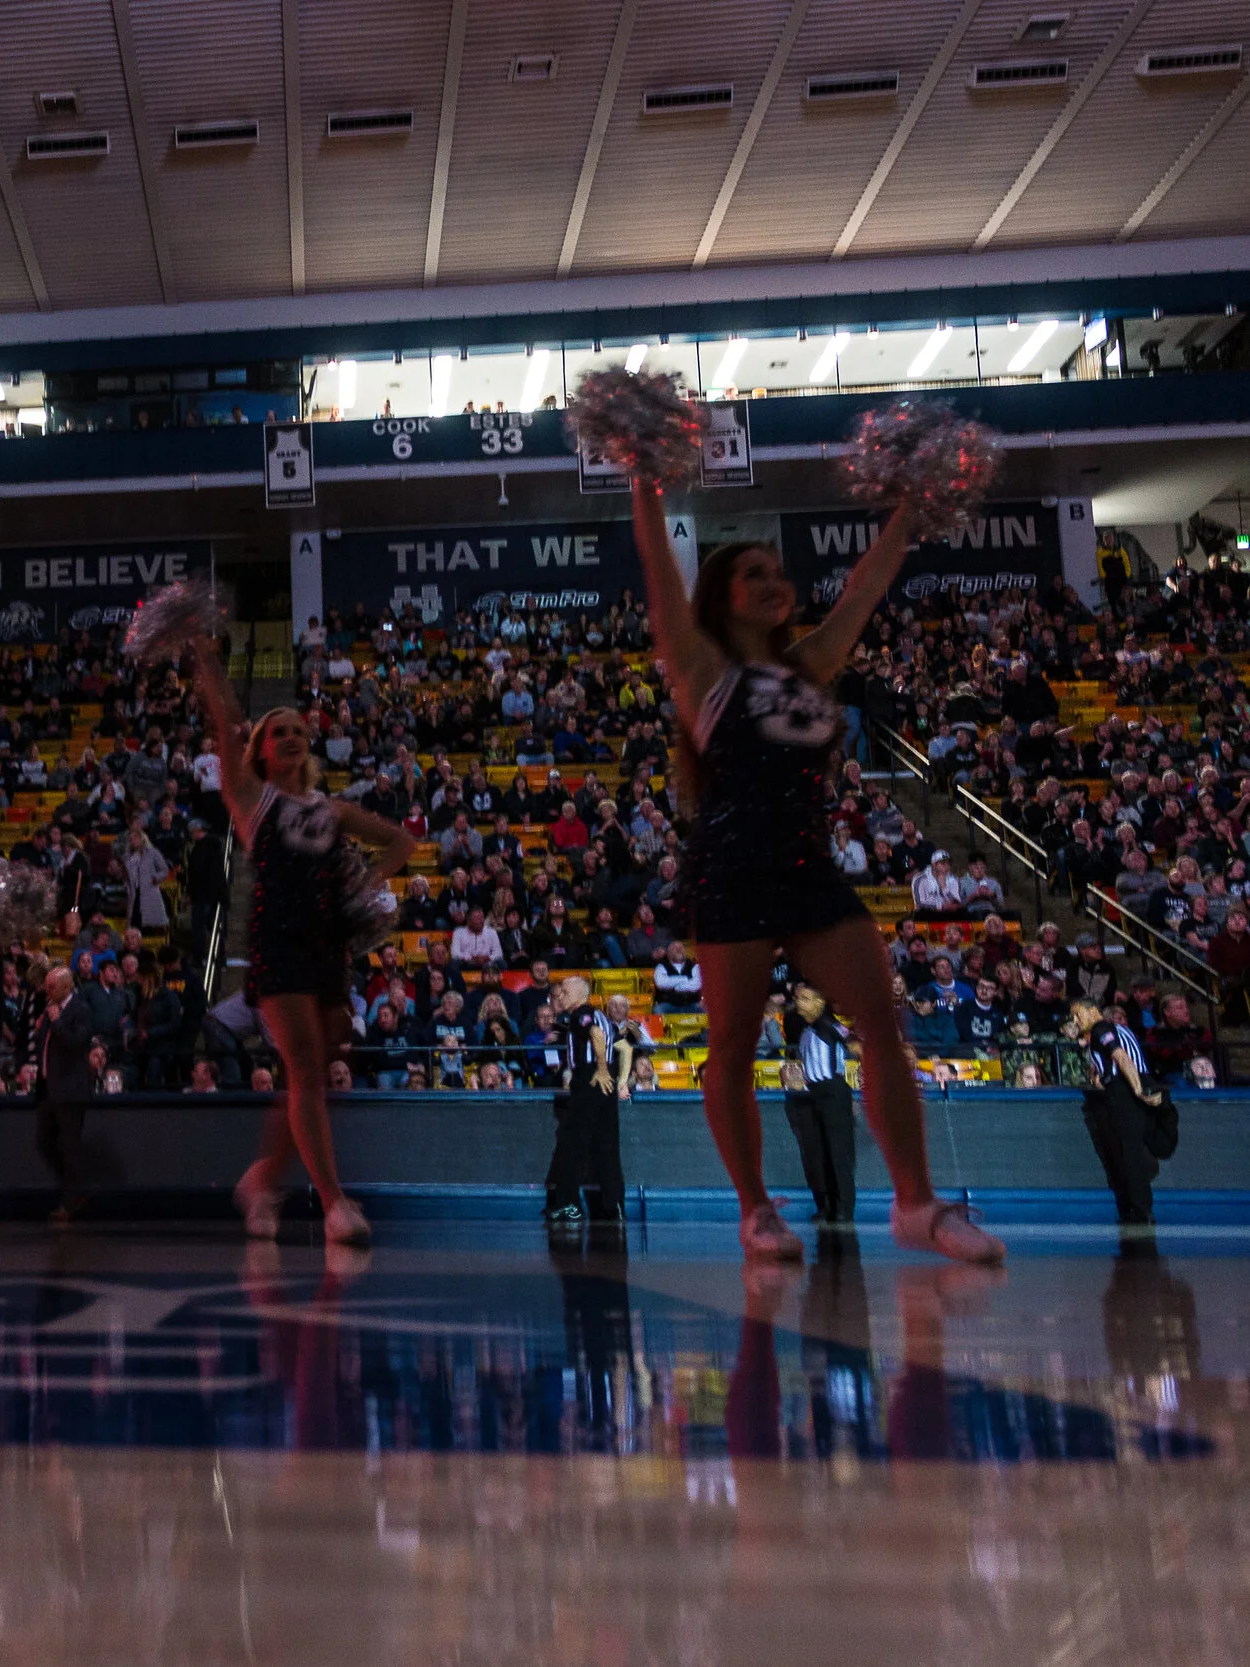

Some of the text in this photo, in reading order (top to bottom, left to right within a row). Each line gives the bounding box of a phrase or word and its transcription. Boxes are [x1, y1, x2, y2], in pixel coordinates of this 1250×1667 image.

[373, 417, 430, 436] COOK
[470, 412, 533, 430] ESTES
[392, 433, 413, 460] 6
[481, 428, 524, 455] 33
[711, 438, 739, 458] 31
[1070, 503, 1085, 520] B
[673, 522, 688, 538] A
[949, 515, 1037, 550] WIN
[299, 539, 312, 554] A
[388, 534, 601, 574] THAT WE
[24, 552, 189, 589] BELIEVE
